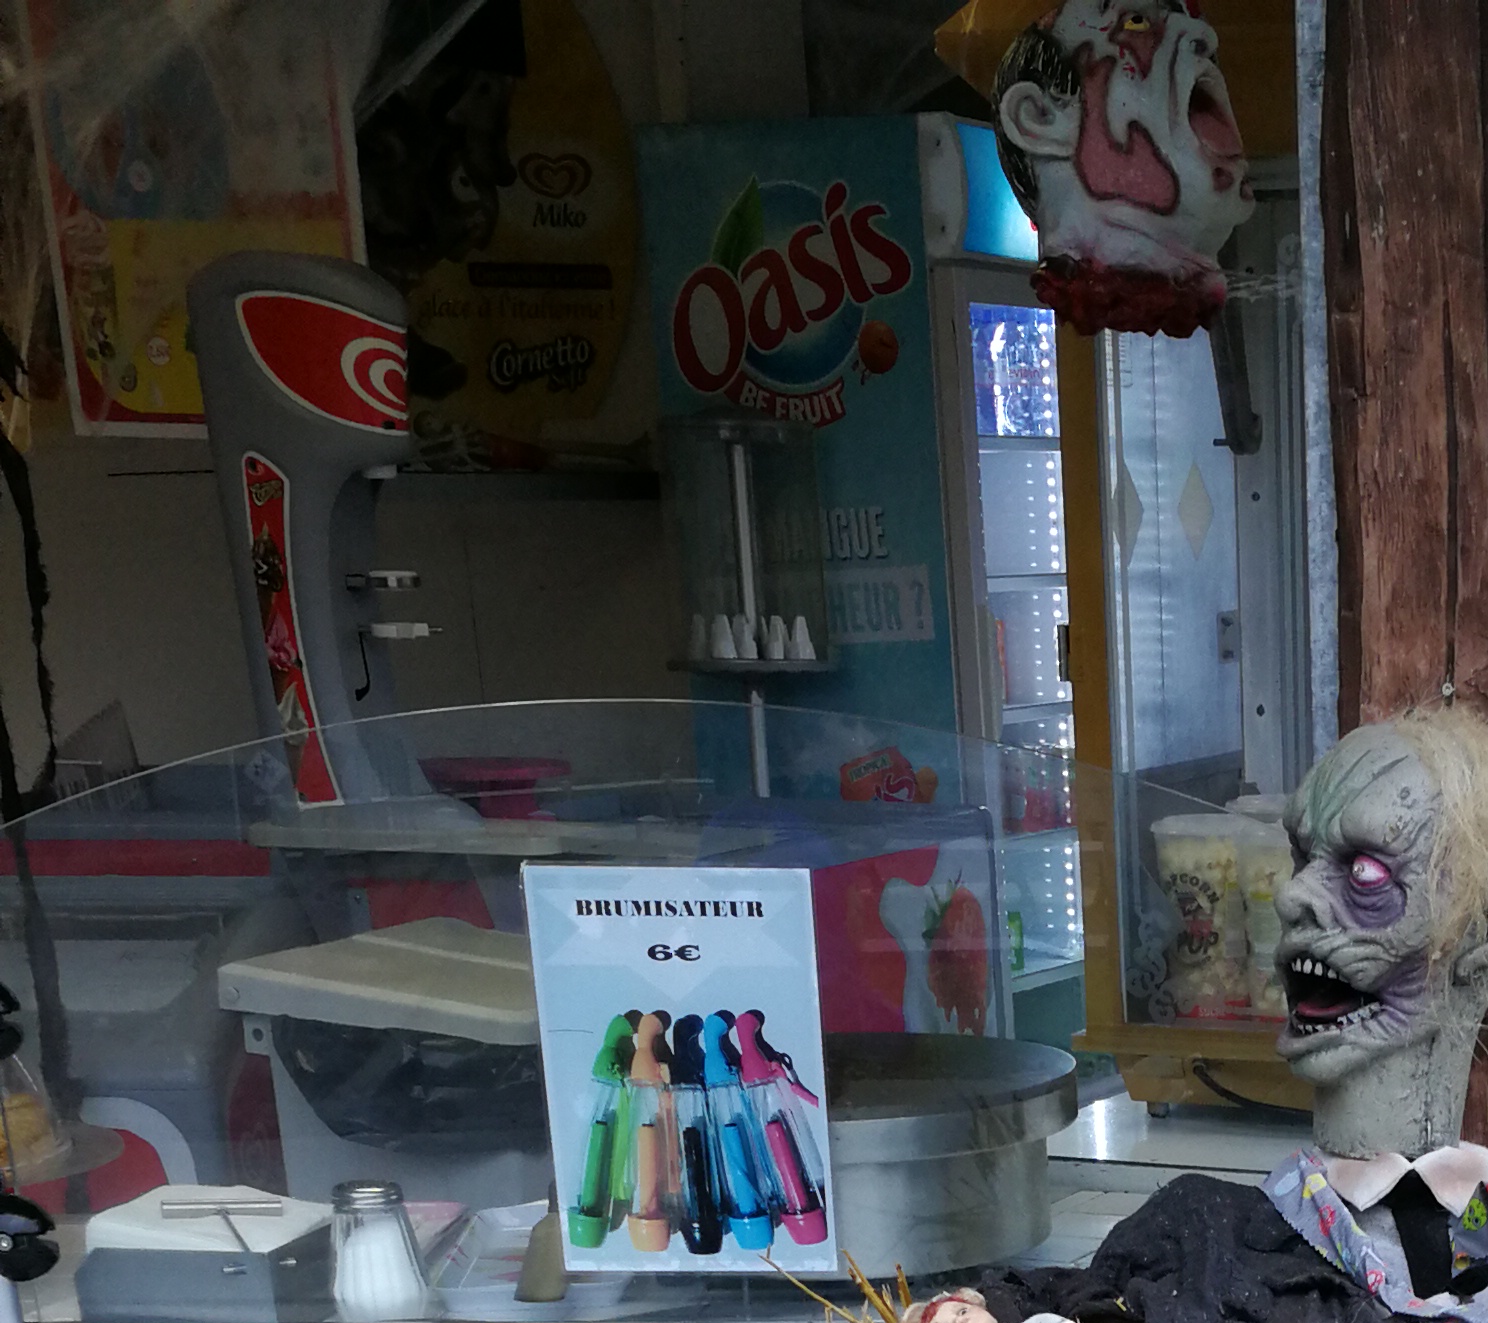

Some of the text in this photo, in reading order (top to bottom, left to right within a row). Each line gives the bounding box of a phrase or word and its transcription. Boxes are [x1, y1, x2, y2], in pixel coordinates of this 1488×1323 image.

[533, 203, 587, 228] Miko
[674, 181, 912, 392] Oasis
[490, 336, 590, 386] Cornetto
[739, 380, 844, 425] BE FRUIT
[575, 899, 764, 918] BRUMISATEUR
[647, 944, 701, 961] 6€
